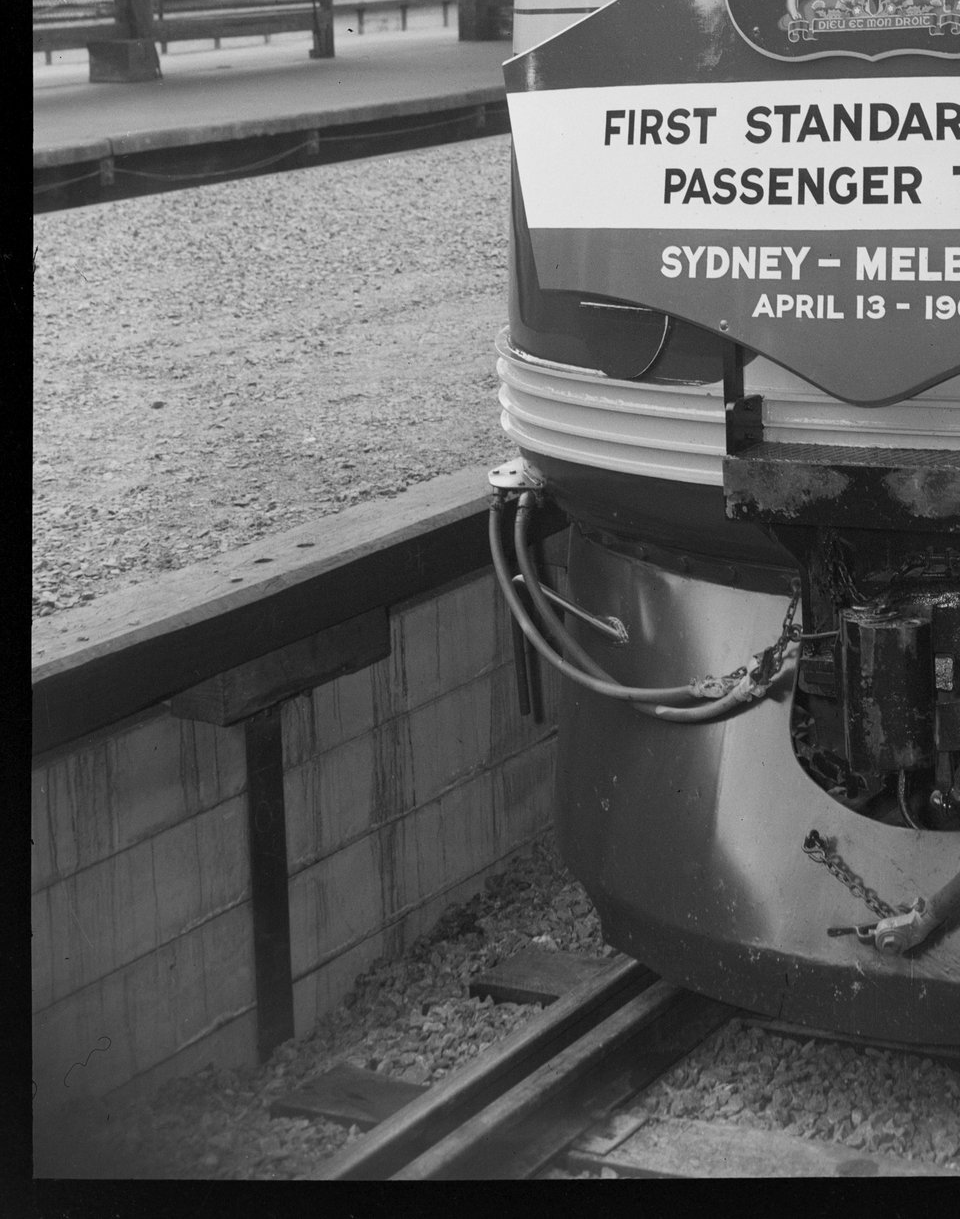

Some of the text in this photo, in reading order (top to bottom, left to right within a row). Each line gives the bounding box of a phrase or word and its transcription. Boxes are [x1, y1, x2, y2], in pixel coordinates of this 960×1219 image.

[604, 107, 717, 146] FIRST
[663, 165, 923, 206] PASSENGER
[660, 245, 811, 281] SYDNEY
[751, 293, 845, 320] APRIL
[856, 294, 886, 320] 13
